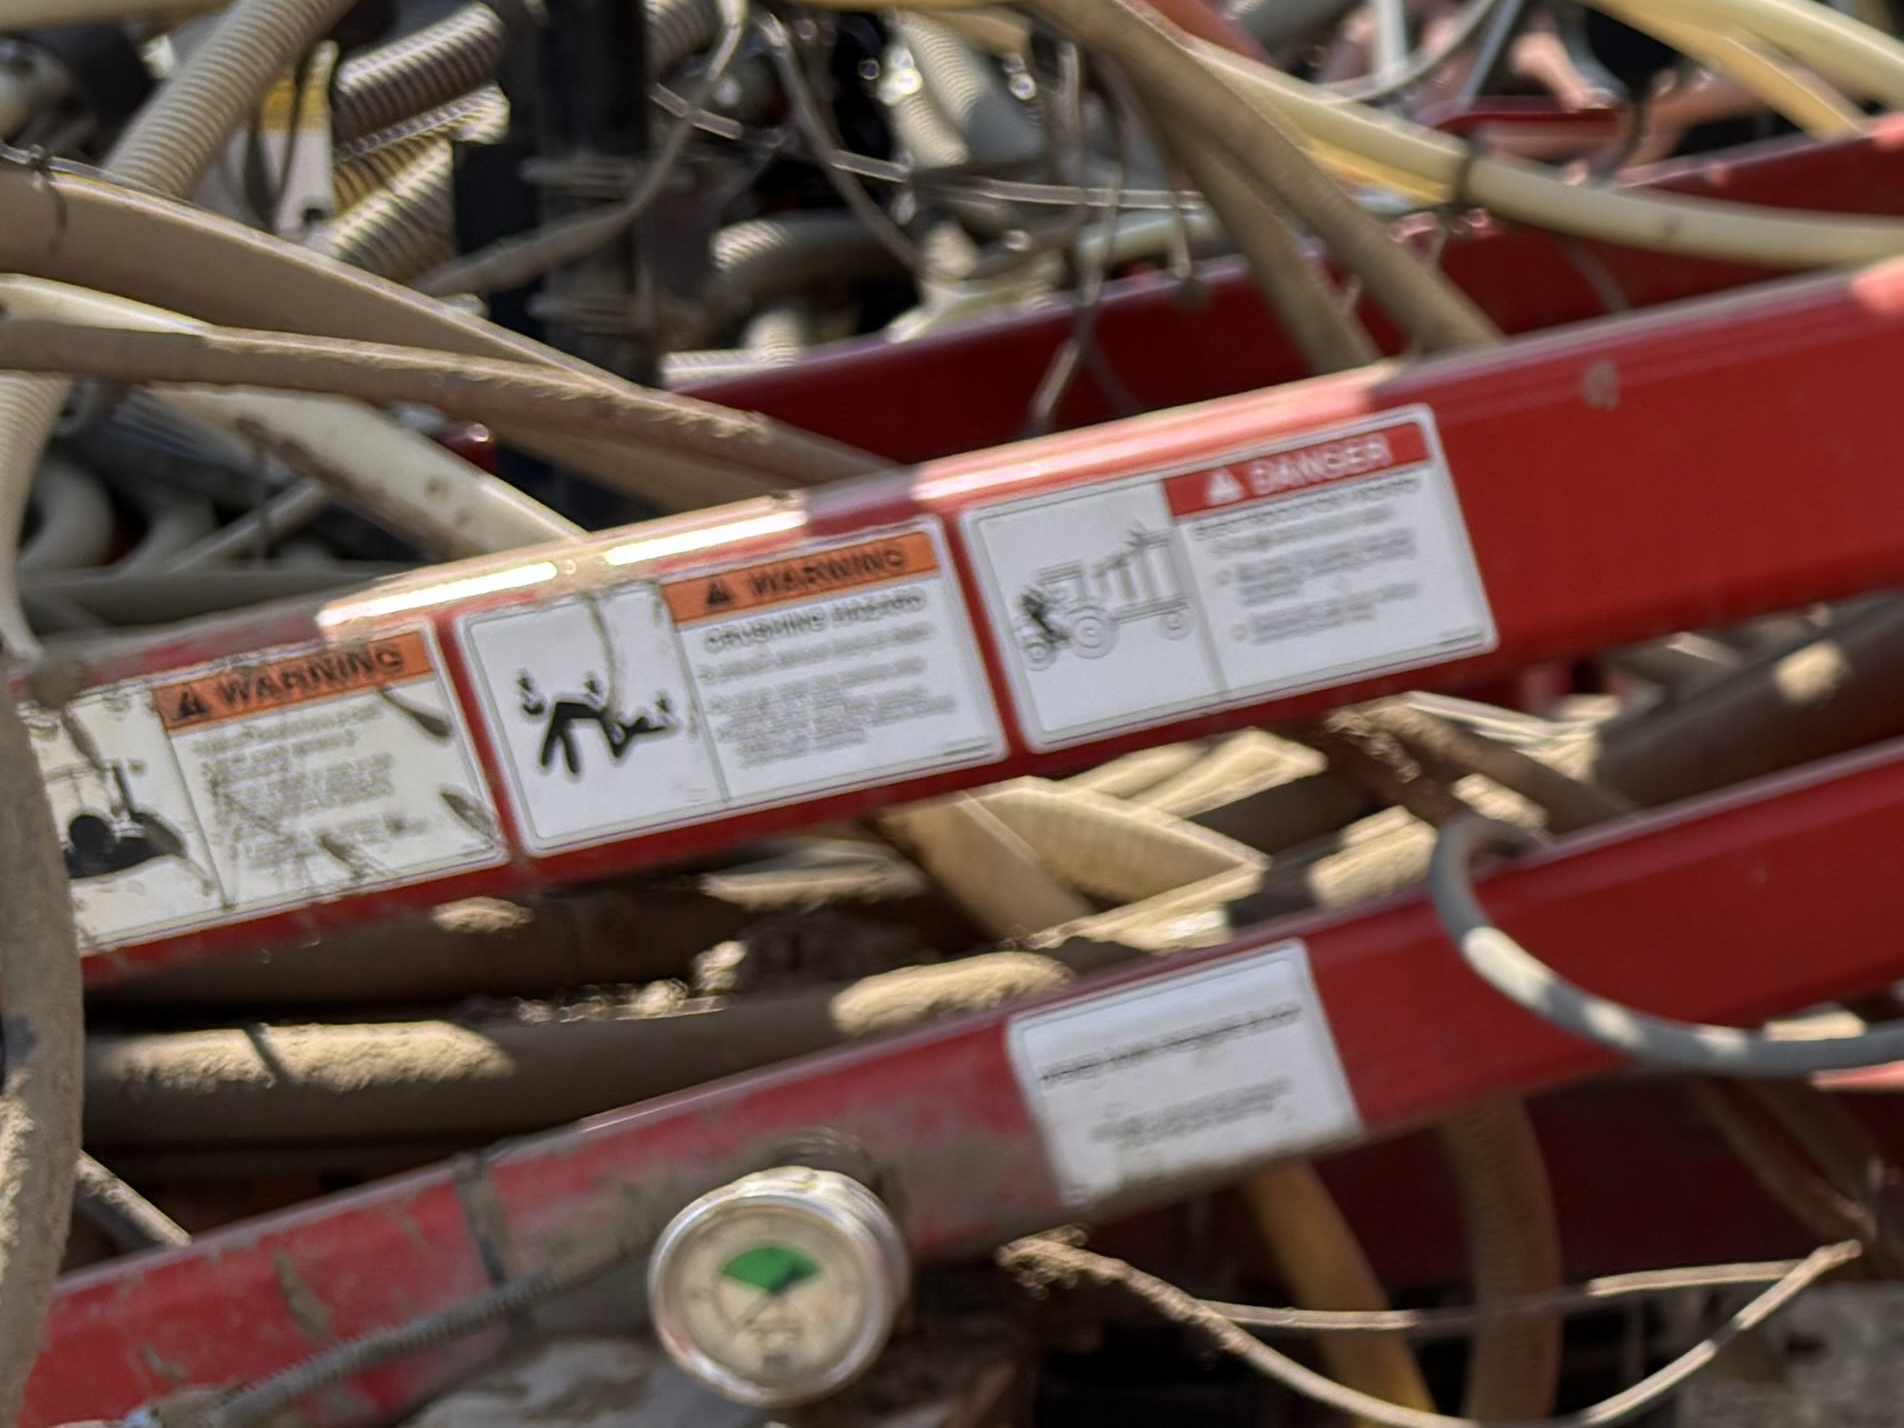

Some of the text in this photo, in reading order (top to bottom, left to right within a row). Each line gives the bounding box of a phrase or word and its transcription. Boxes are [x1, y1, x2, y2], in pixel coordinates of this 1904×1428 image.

[1248, 433, 1395, 498] DANGER
[745, 543, 908, 600] WARNING
[217, 642, 405, 708] WARNING
